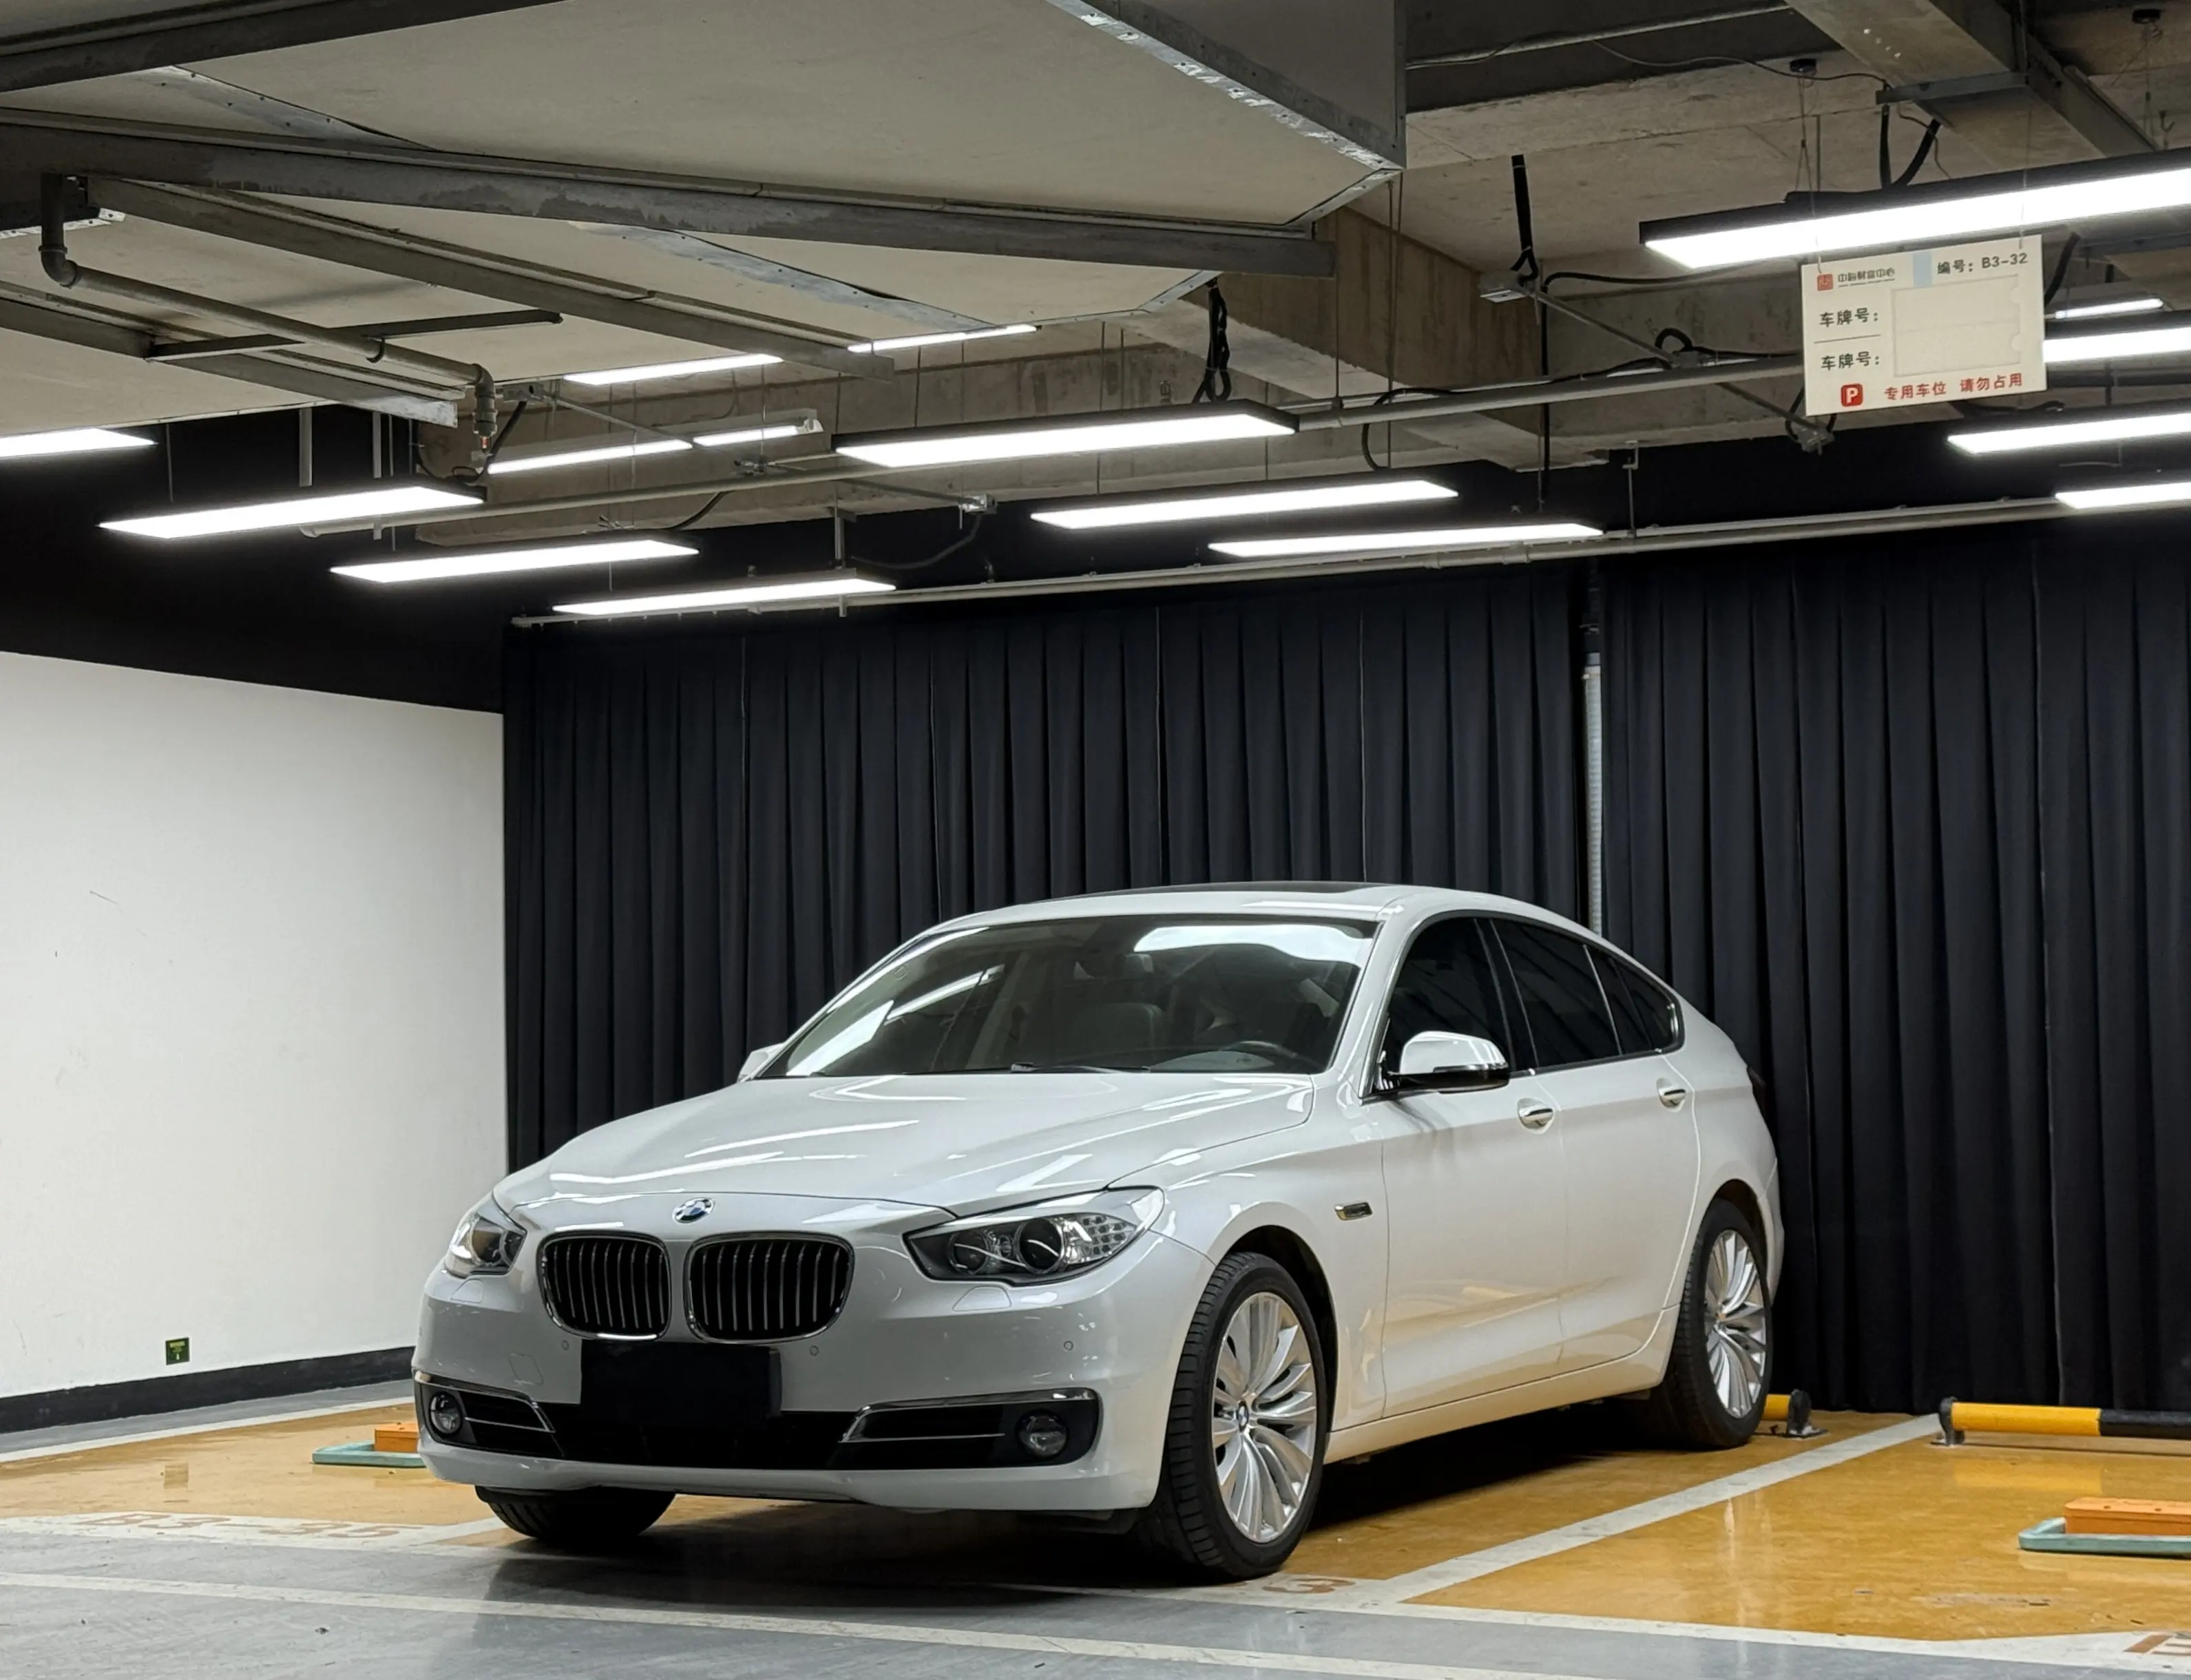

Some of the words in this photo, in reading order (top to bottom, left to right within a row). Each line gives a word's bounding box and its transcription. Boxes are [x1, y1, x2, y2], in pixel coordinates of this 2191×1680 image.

[1981, 252, 2028, 269] B3-32
[1819, 307, 1878, 328] 车牌号：
[1821, 351, 1880, 371] 车牌号：
[1884, 381, 1947, 401] 专用车位
[1960, 372, 2023, 392] 请勿占用
